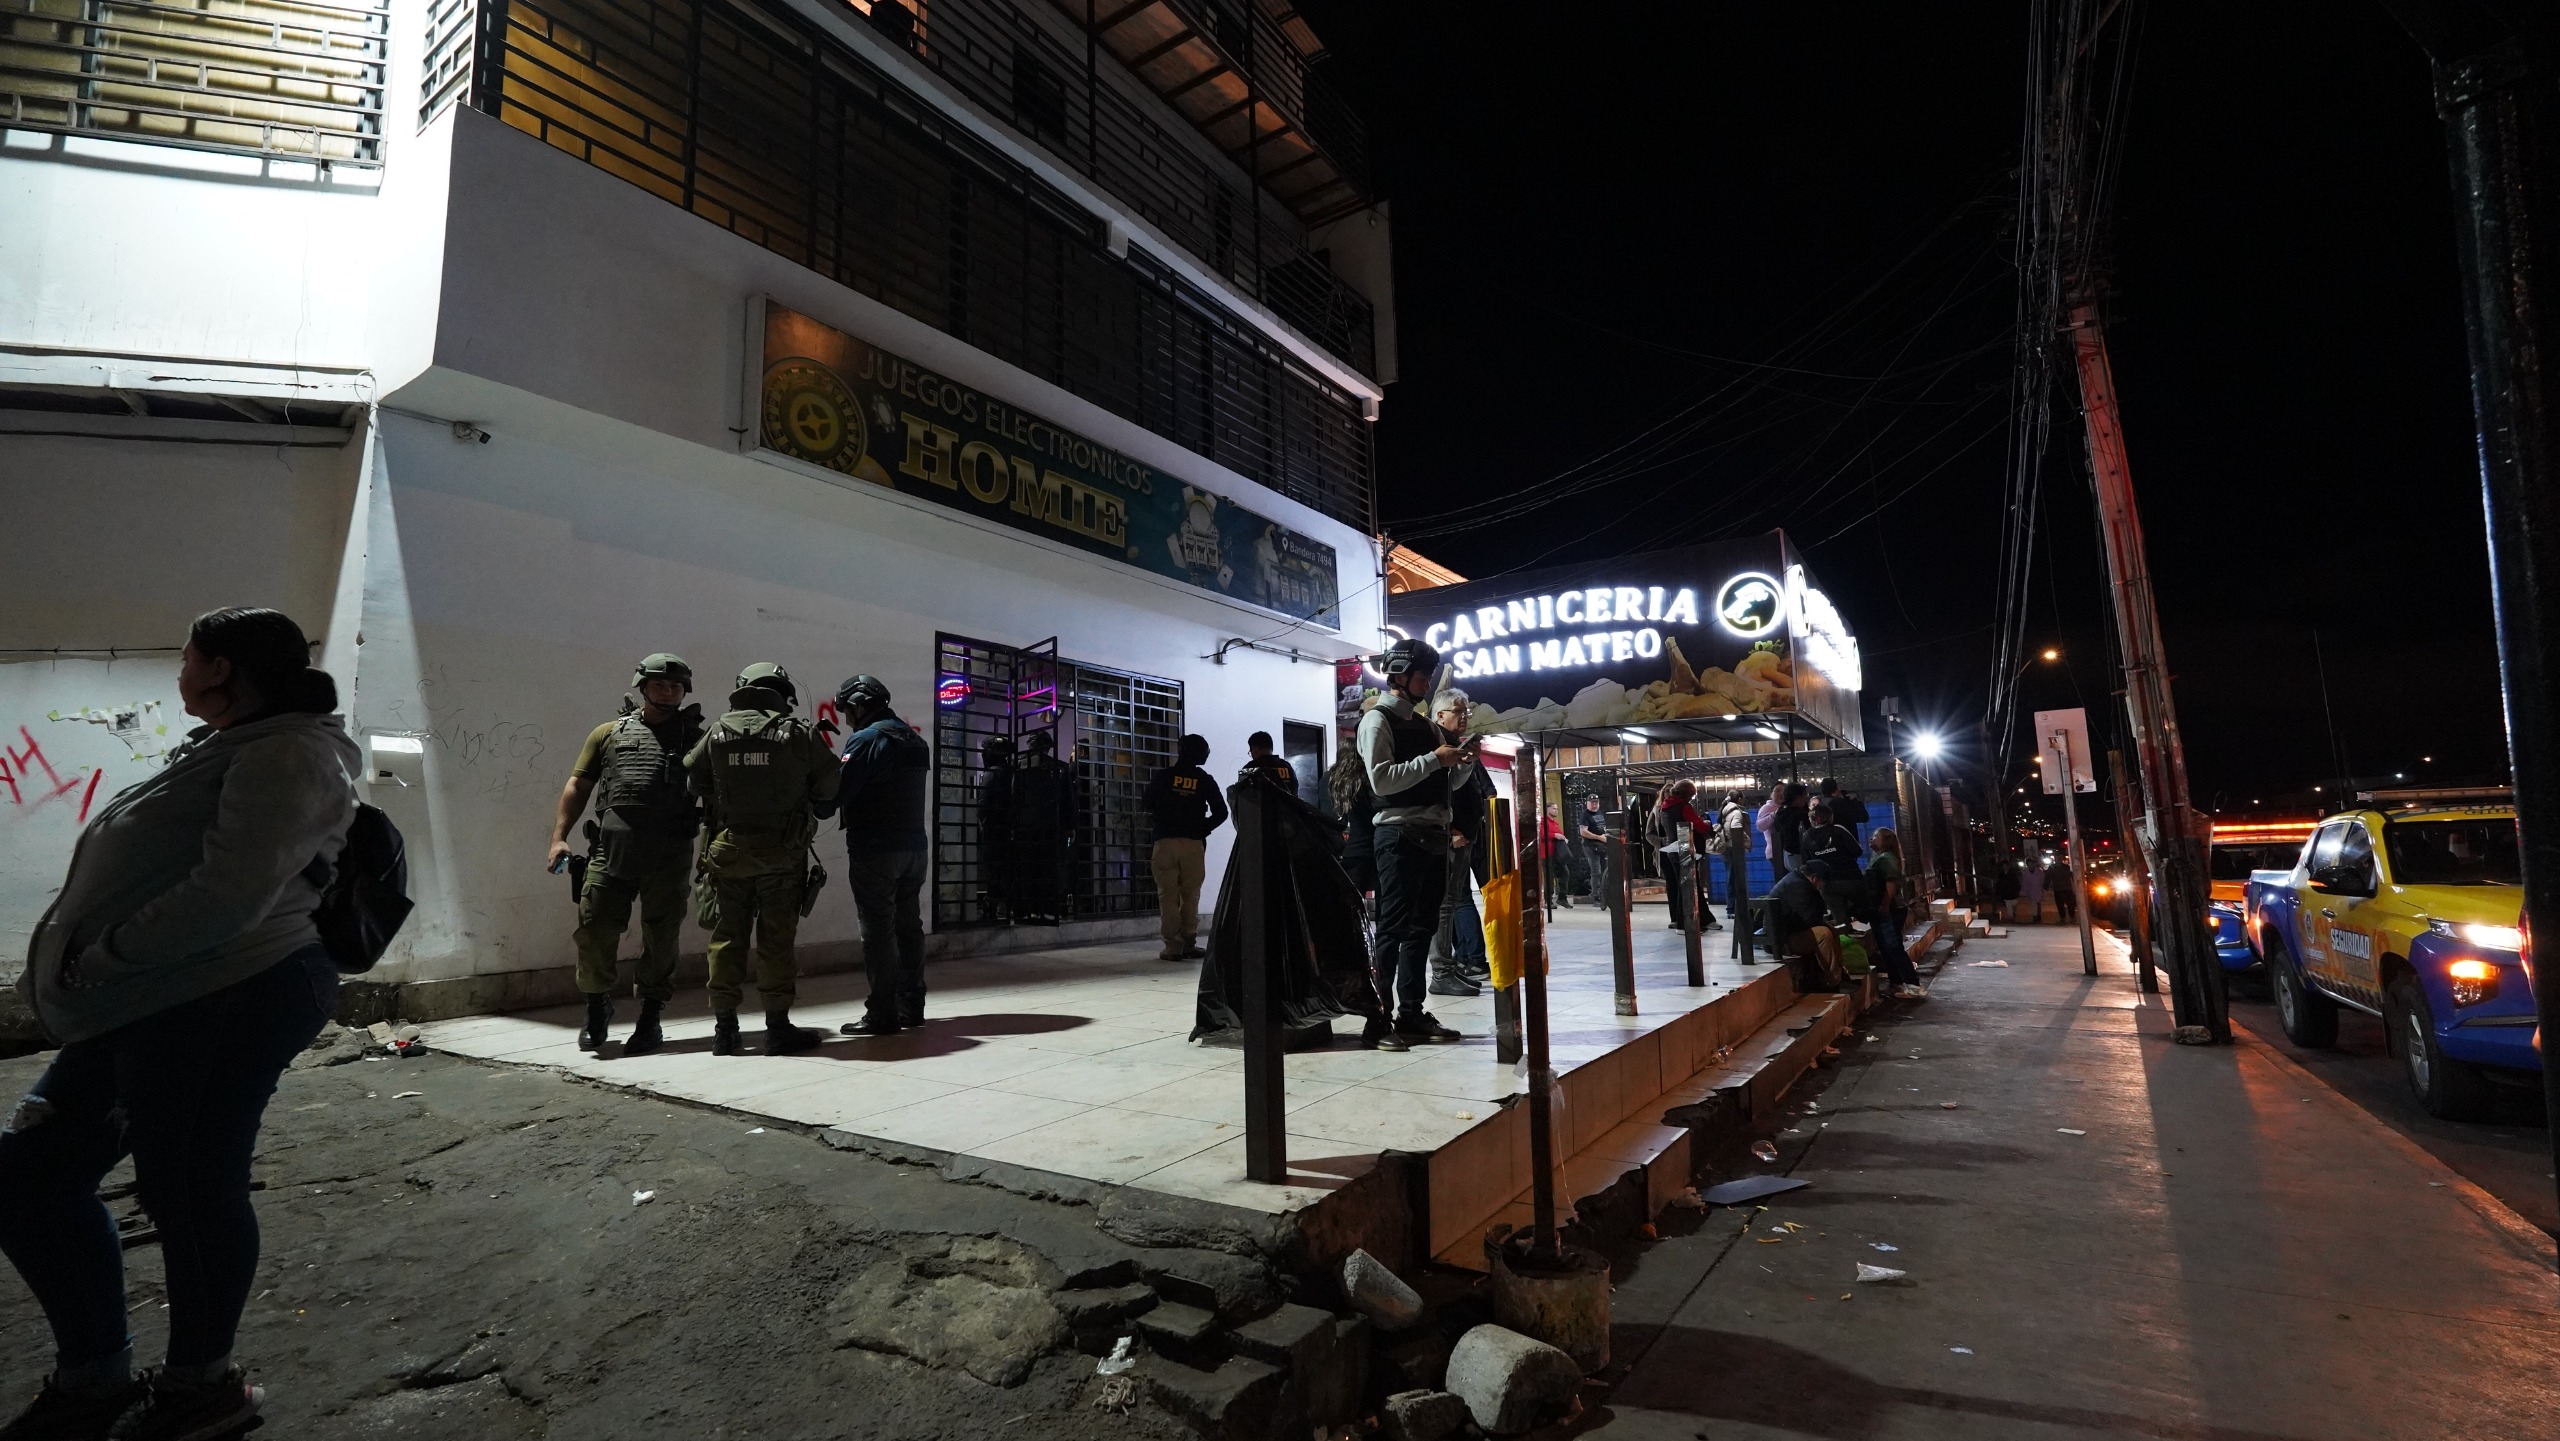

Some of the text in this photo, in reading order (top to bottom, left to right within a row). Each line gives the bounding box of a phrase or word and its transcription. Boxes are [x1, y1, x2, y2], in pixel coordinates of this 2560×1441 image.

[859, 350, 1153, 495] JUEGOS ELECTRONICOS
[898, 411, 1126, 548] HOMIE
[1289, 541, 1332, 568] Bandera 7494
[1425, 586, 1699, 652] CARNICERIA
[1453, 628, 1662, 679] SAN MATEO
[728, 752, 770, 766] DE CHILE
[1173, 776, 1198, 790] PDI
[2331, 928, 2370, 960] SEGURIDAD
